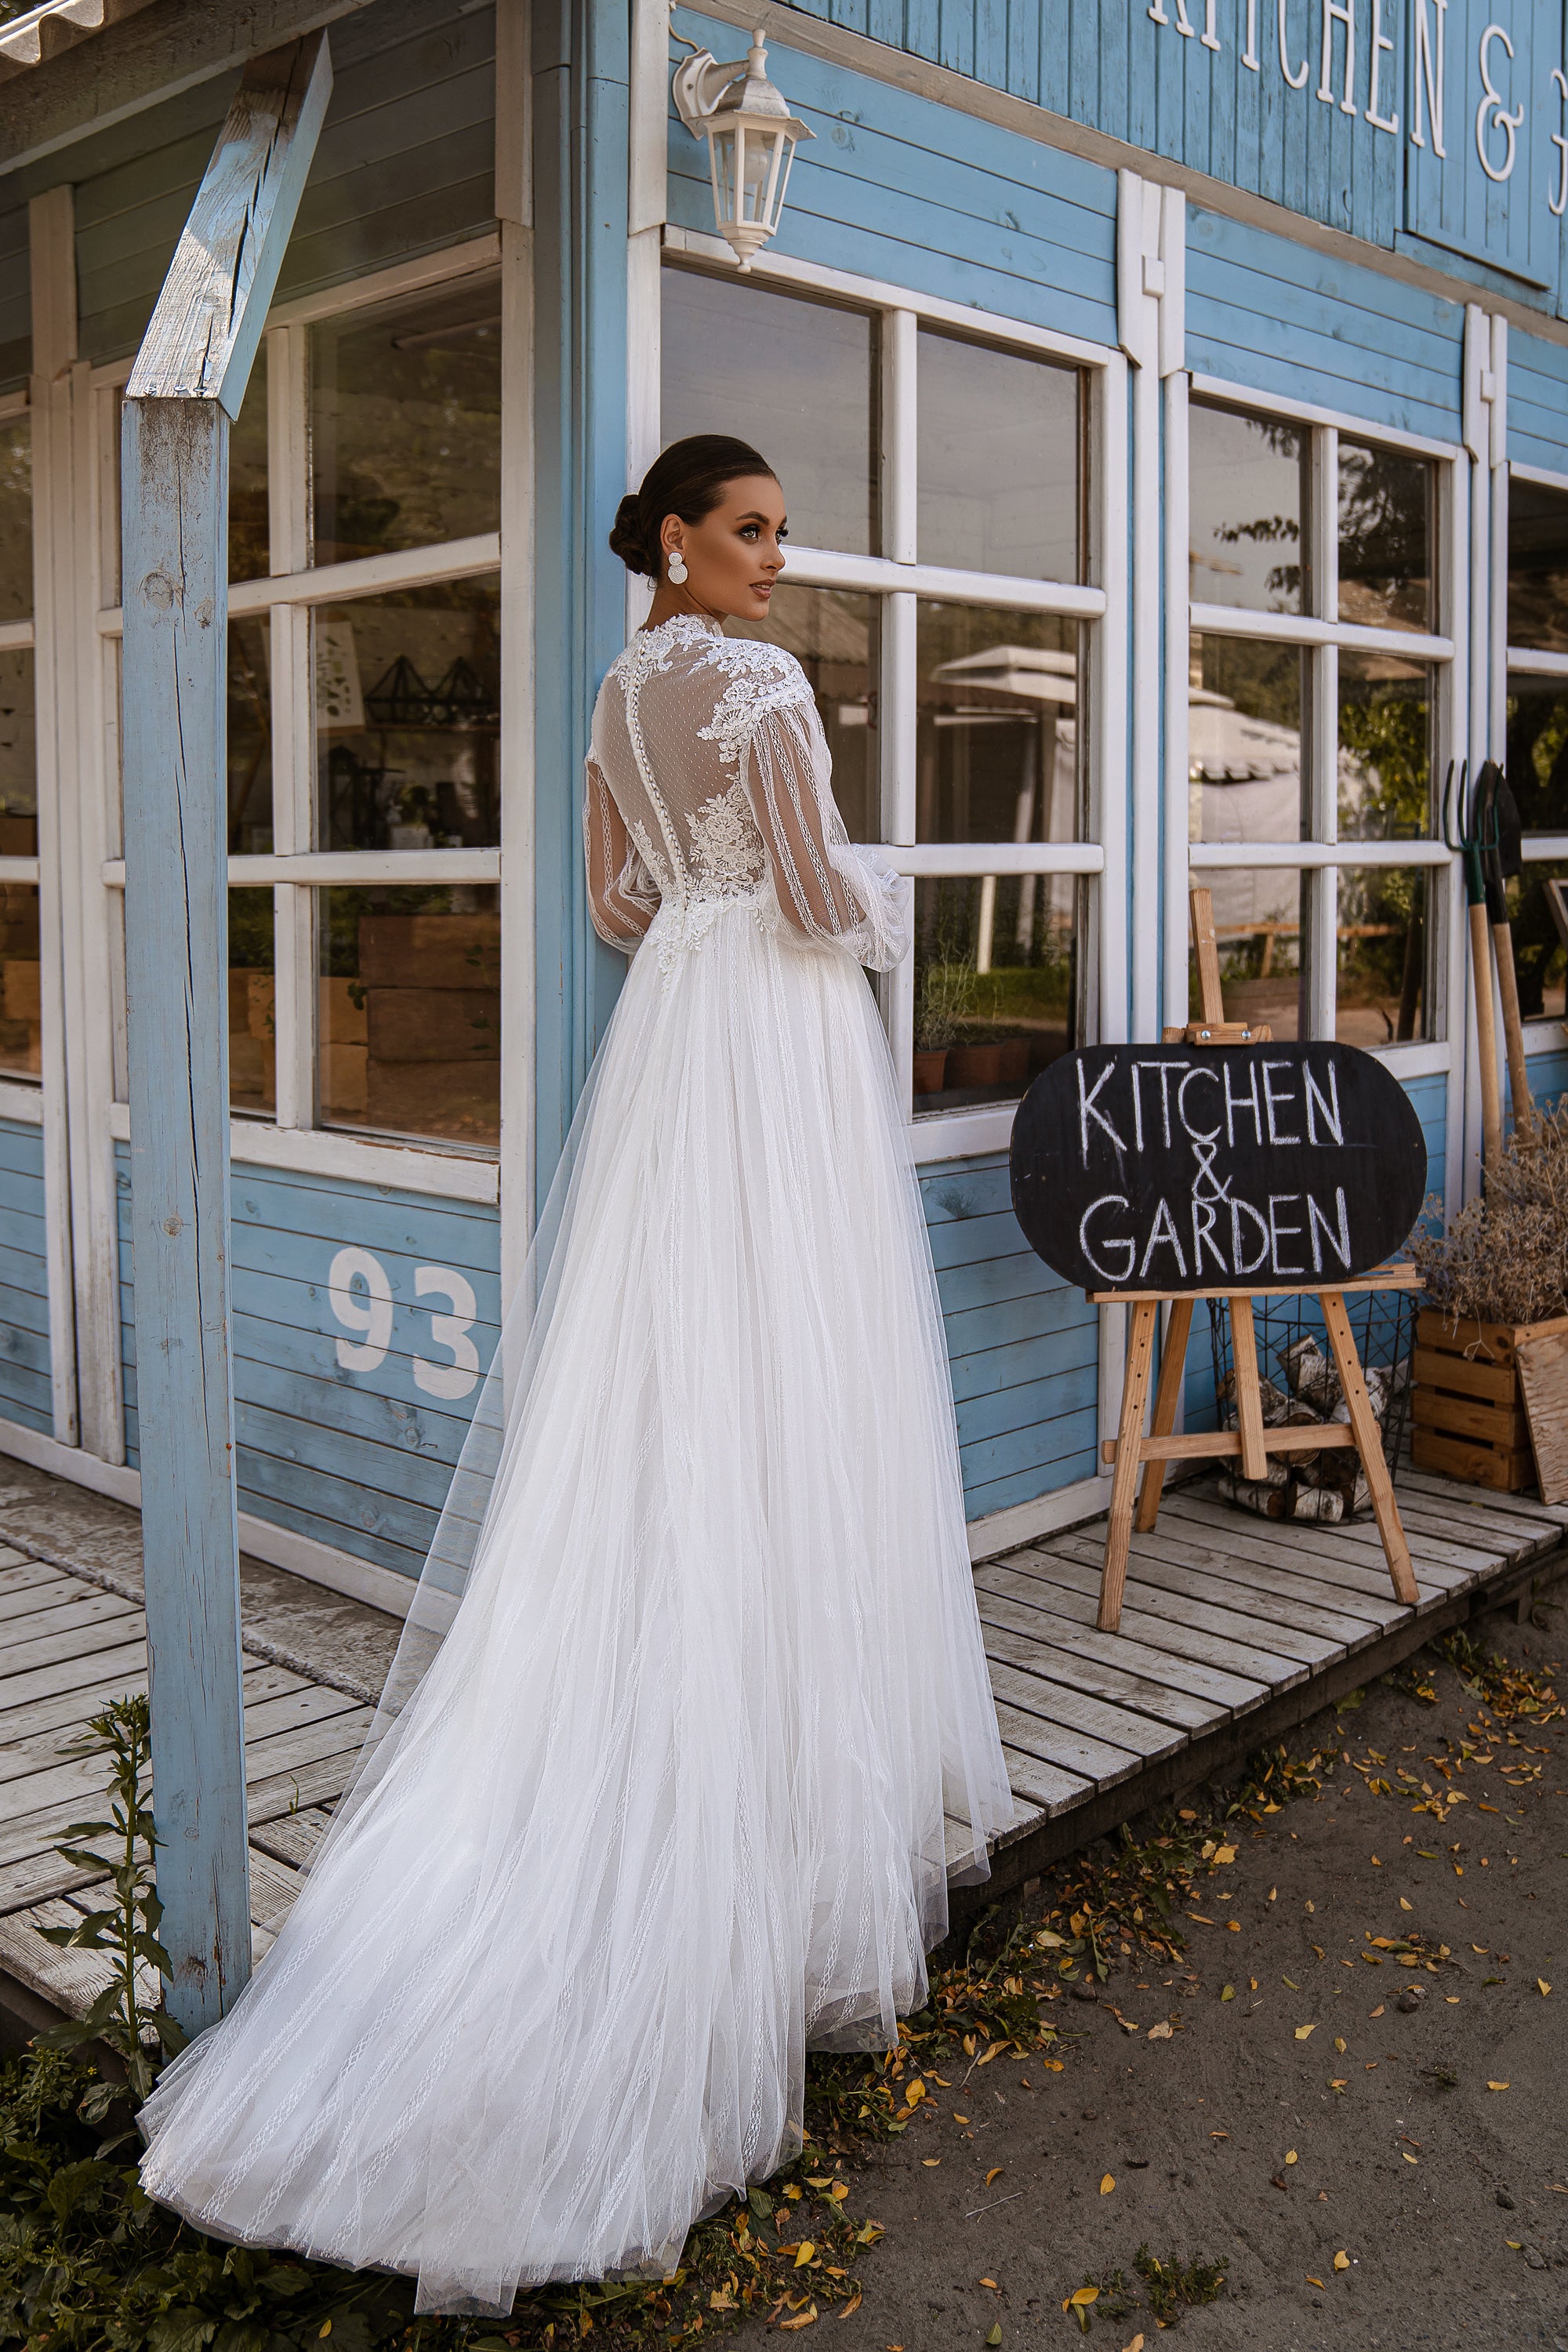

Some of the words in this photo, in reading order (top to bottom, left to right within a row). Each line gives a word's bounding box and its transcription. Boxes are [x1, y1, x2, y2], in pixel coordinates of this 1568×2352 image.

[1148, 0, 1447, 159] CHEN
[1476, 24, 1524, 182] &
[1076, 1054, 1344, 1171] KITCHEN
[1189, 1140, 1233, 1203] &
[1079, 1186, 1352, 1282] GARDEN
[328, 1247, 480, 1400] 93
